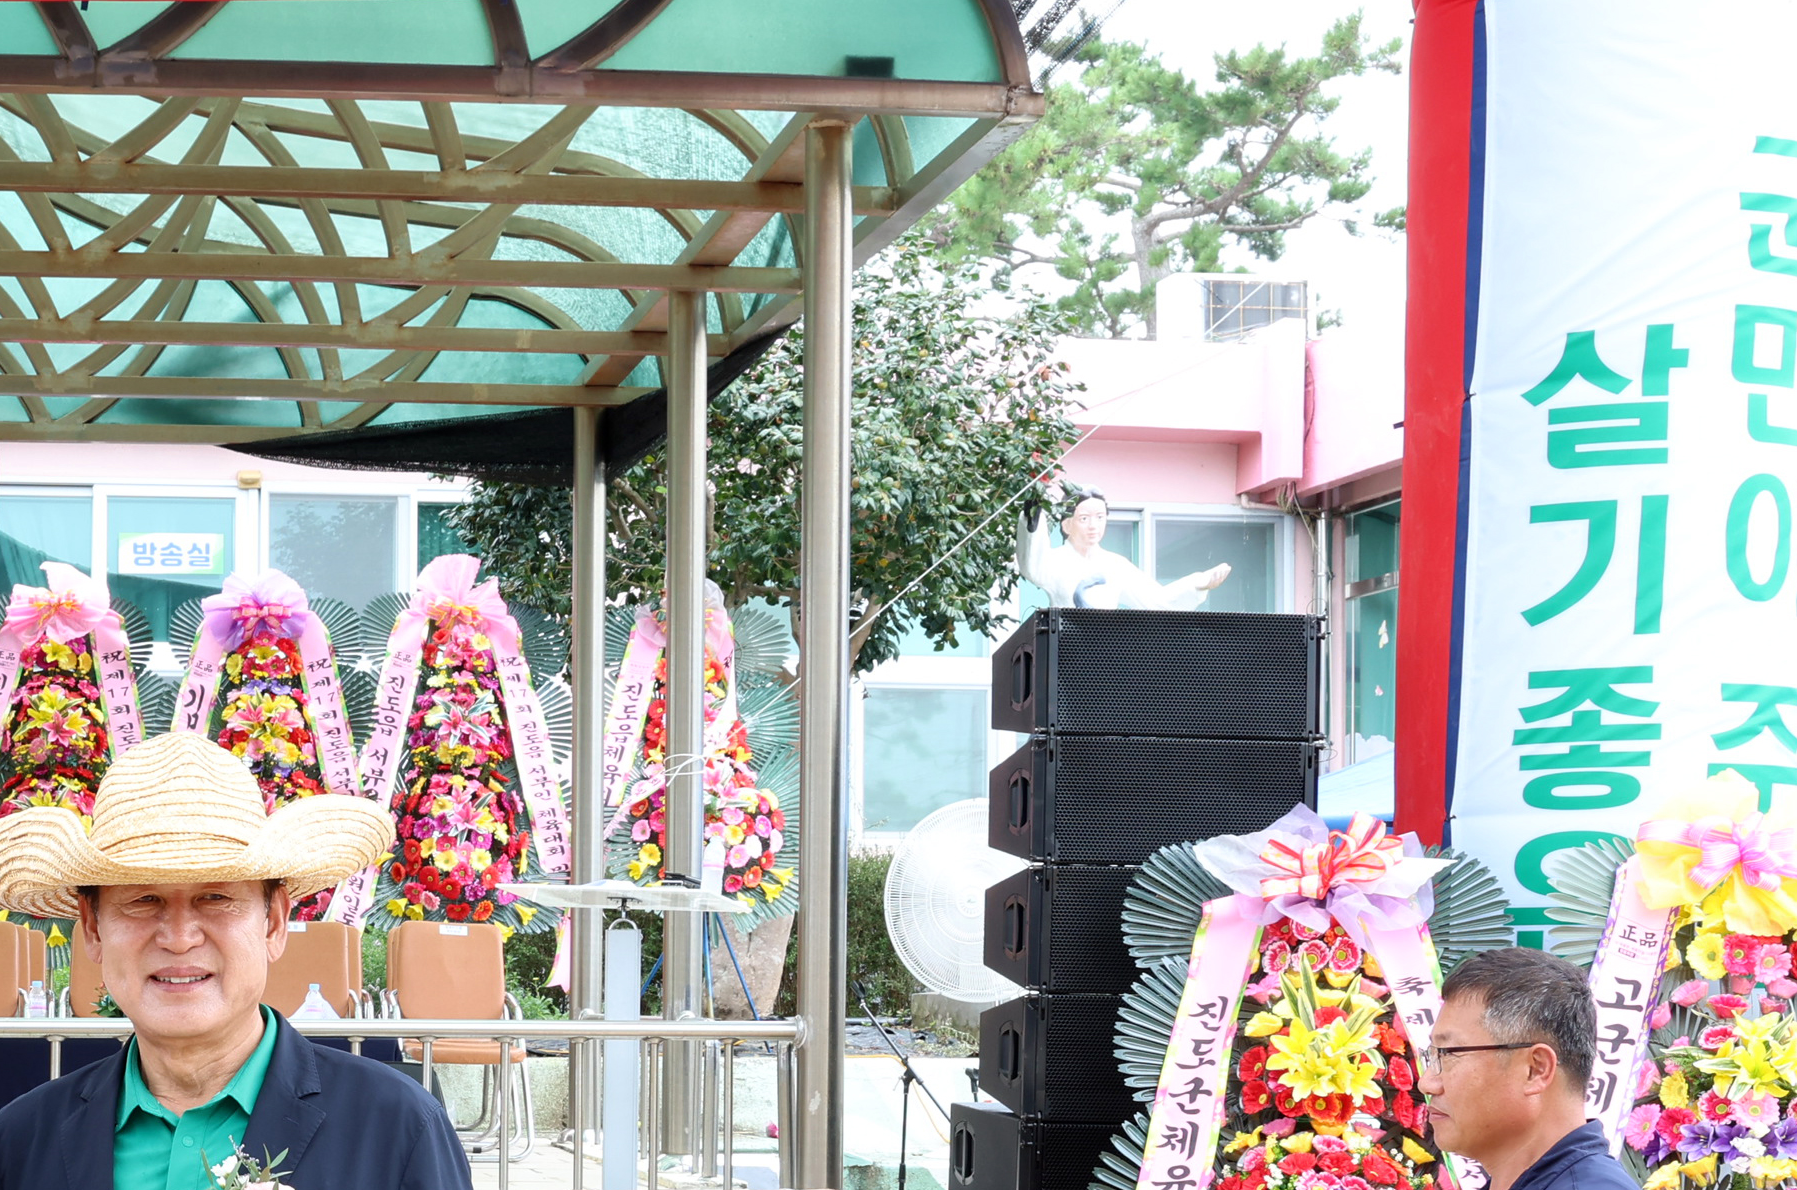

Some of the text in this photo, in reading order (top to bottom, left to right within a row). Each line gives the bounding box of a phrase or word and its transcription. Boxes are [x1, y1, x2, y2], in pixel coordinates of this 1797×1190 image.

[133, 542, 211, 567] 방송실
[101, 650, 126, 664] 祝
[307, 658, 332, 673] 祝
[377, 675, 405, 738] 진도읍
[114, 722, 141, 750] 진도
[331, 766, 355, 796] 서부
[537, 808, 567, 857] 체육대회
[1618, 924, 1659, 949] 正品
